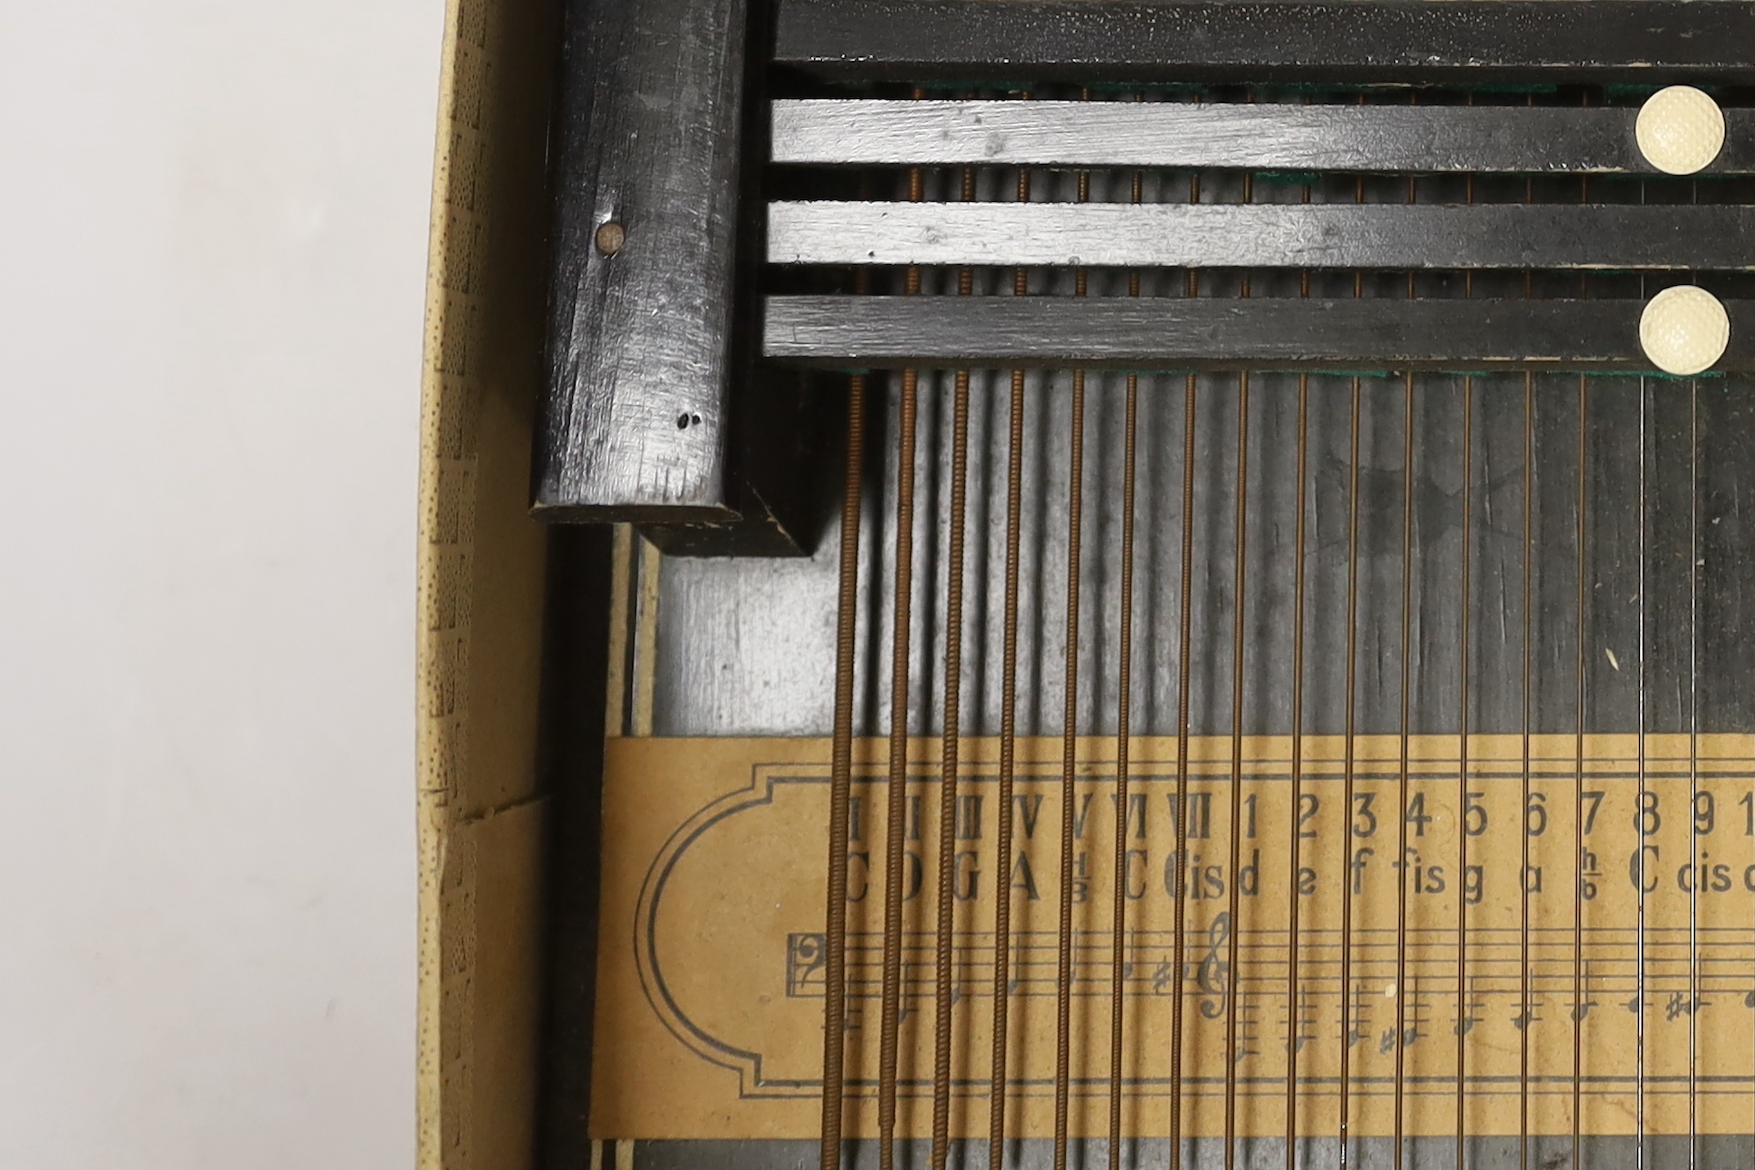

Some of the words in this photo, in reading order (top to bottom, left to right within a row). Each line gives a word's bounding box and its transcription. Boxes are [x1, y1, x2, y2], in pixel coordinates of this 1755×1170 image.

[1012, 794, 1045, 840] V
[1244, 793, 1259, 838] 1
[1299, 793, 1320, 838] 2
[1353, 792, 1377, 838] 3
[1405, 792, 1432, 837] 4
[1464, 792, 1488, 837] 5
[1526, 793, 1548, 837] 6
[1581, 791, 1606, 836] 7
[1633, 791, 1661, 836] 8
[1692, 790, 1715, 835] 9
[953, 850, 981, 901] G
[1011, 850, 1041, 901] A
[1125, 849, 1148, 900] C
[1164, 848, 1226, 900] Cis
[1238, 848, 1260, 897] d
[1351, 847, 1374, 894] f
[1463, 864, 1484, 904] g
[1520, 865, 1542, 894] a
[1629, 845, 1660, 894] C
[1678, 852, 1732, 893] cis
